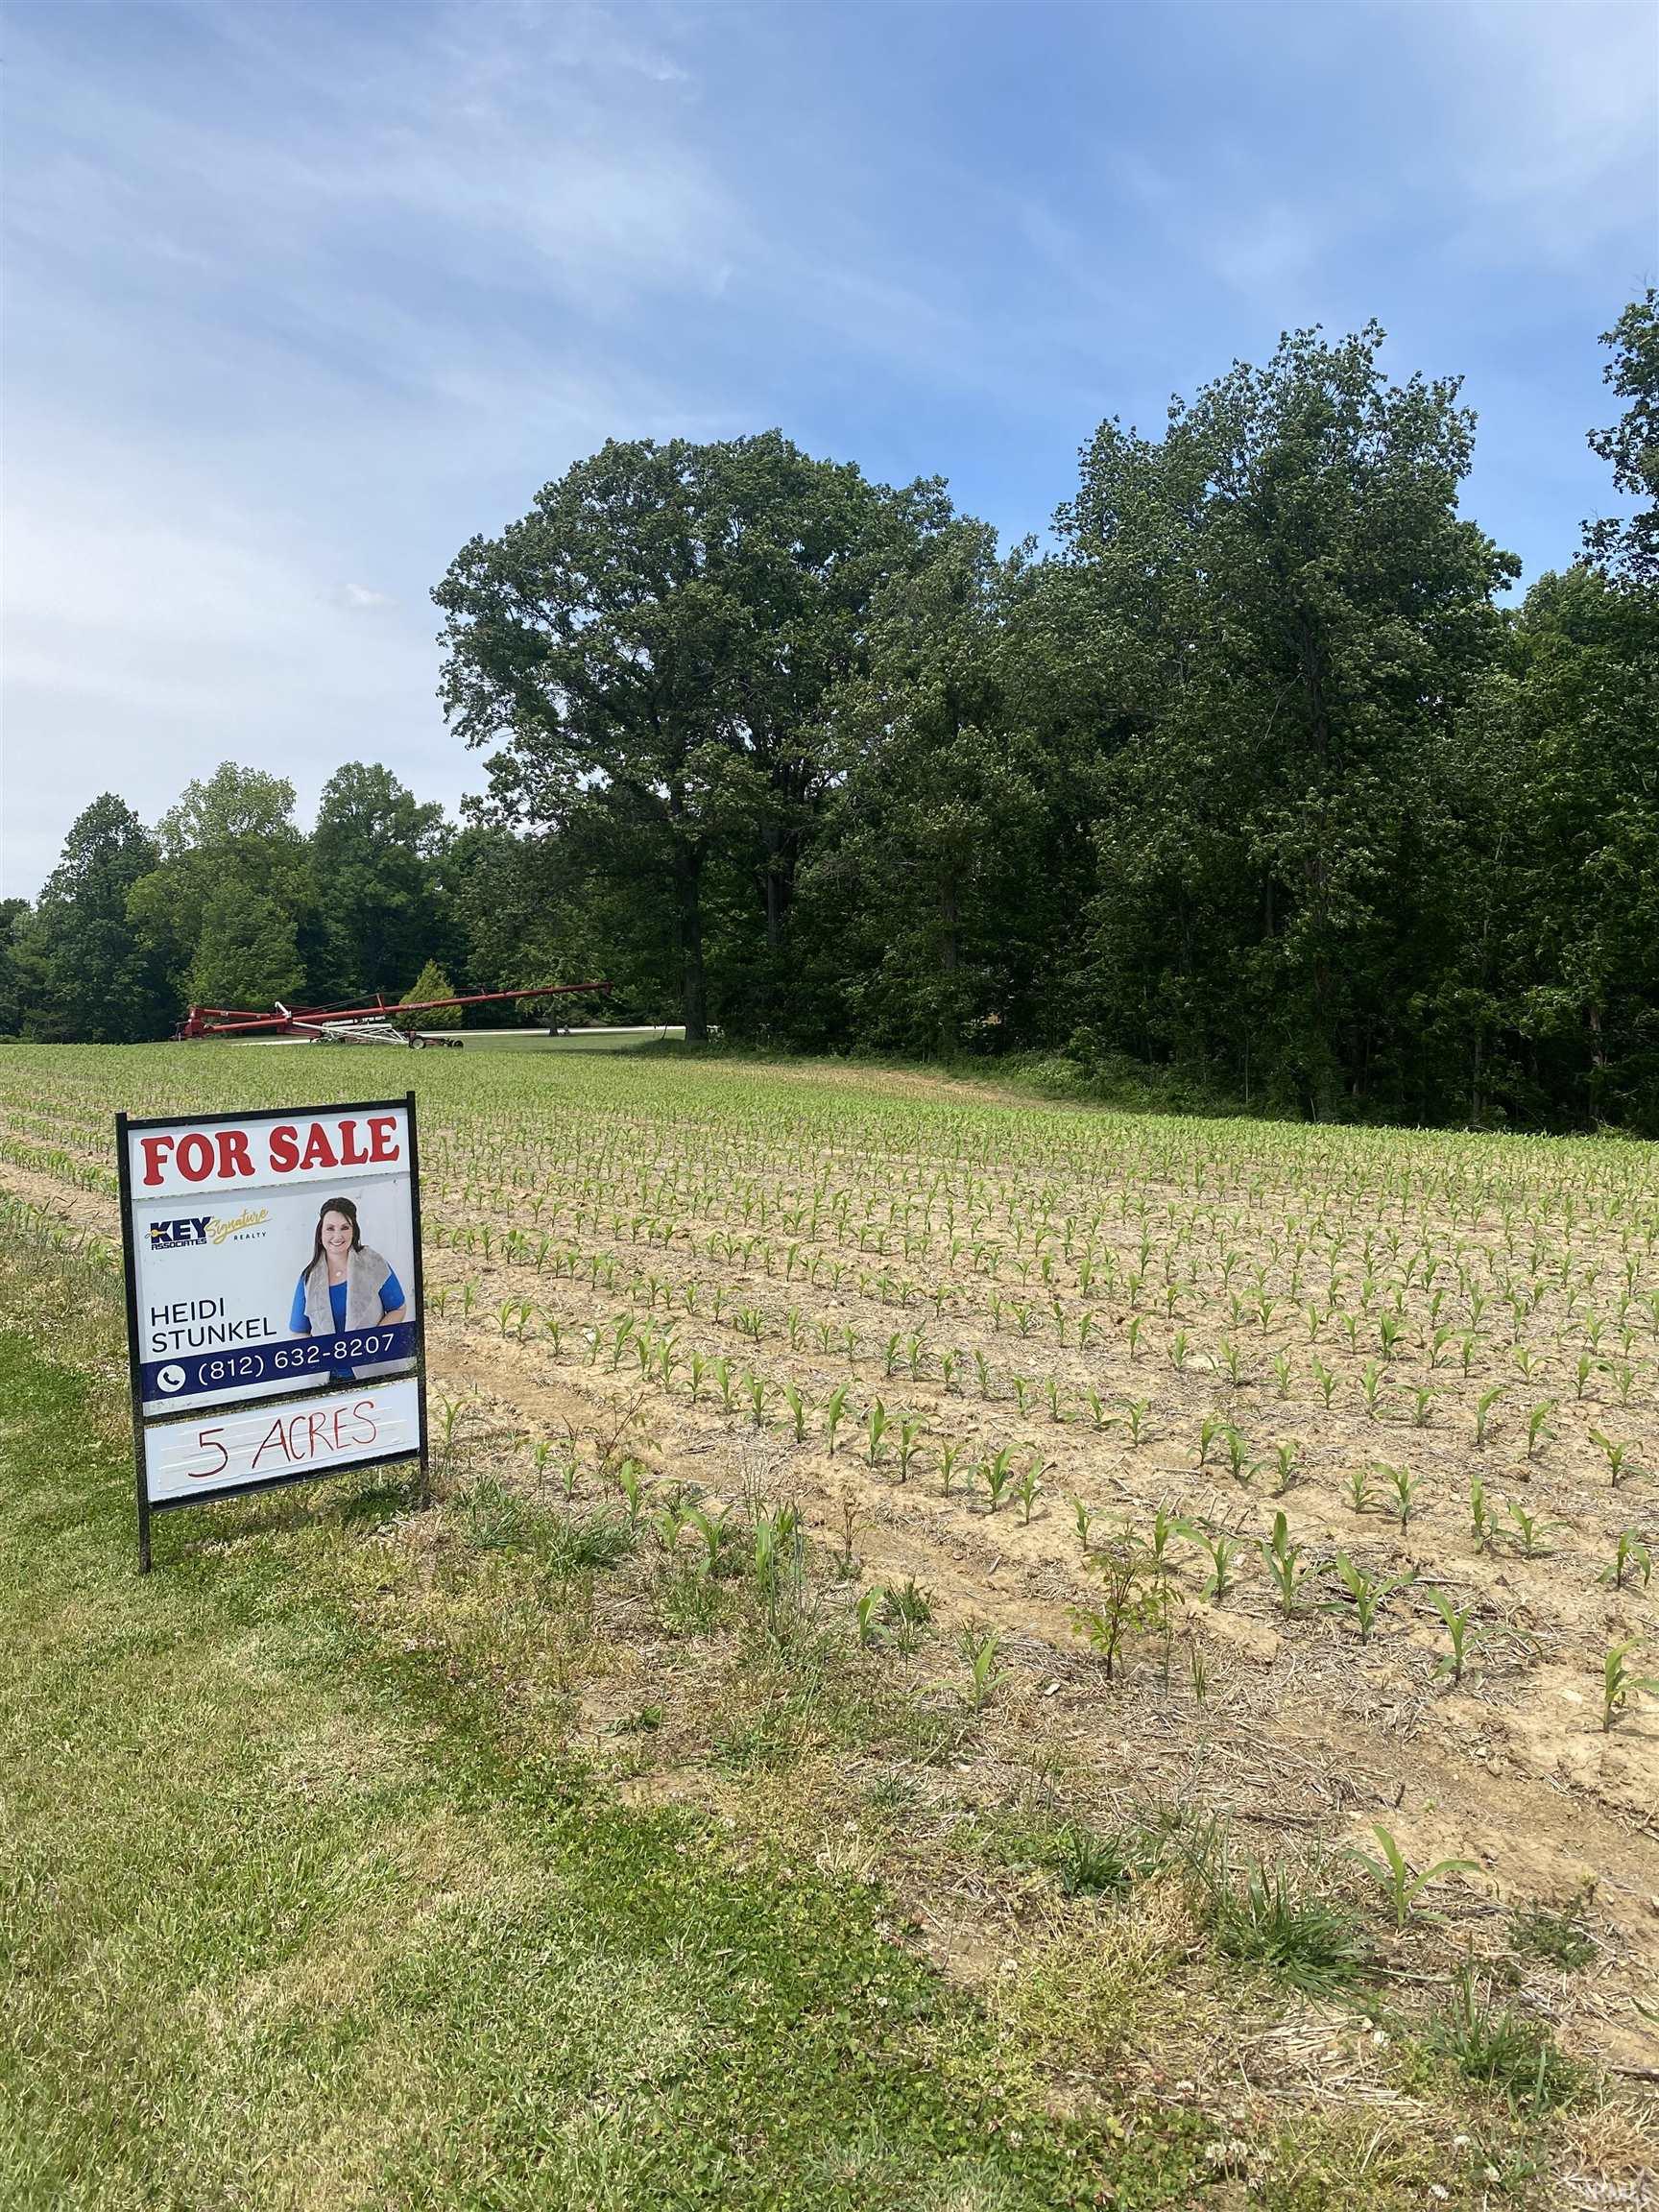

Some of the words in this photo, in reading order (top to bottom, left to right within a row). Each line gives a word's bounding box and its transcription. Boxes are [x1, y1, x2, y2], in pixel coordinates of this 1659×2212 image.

[140, 1130, 255, 1186] FOR
[269, 1117, 399, 1173] SALE
[150, 1216, 211, 1243] KEY
[205, 1207, 269, 1245] Signature
[151, 1238, 207, 1250] ASSOCIATES
[233, 1232, 267, 1240] REALTY
[151, 1297, 225, 1327] HEIDI
[152, 1317, 277, 1353] STUNKEL
[198, 1355, 264, 1385] (812)
[275, 1334, 395, 1369] 632-8207
[188, 1428, 229, 1478] 5
[252, 1401, 376, 1469] ACRES
